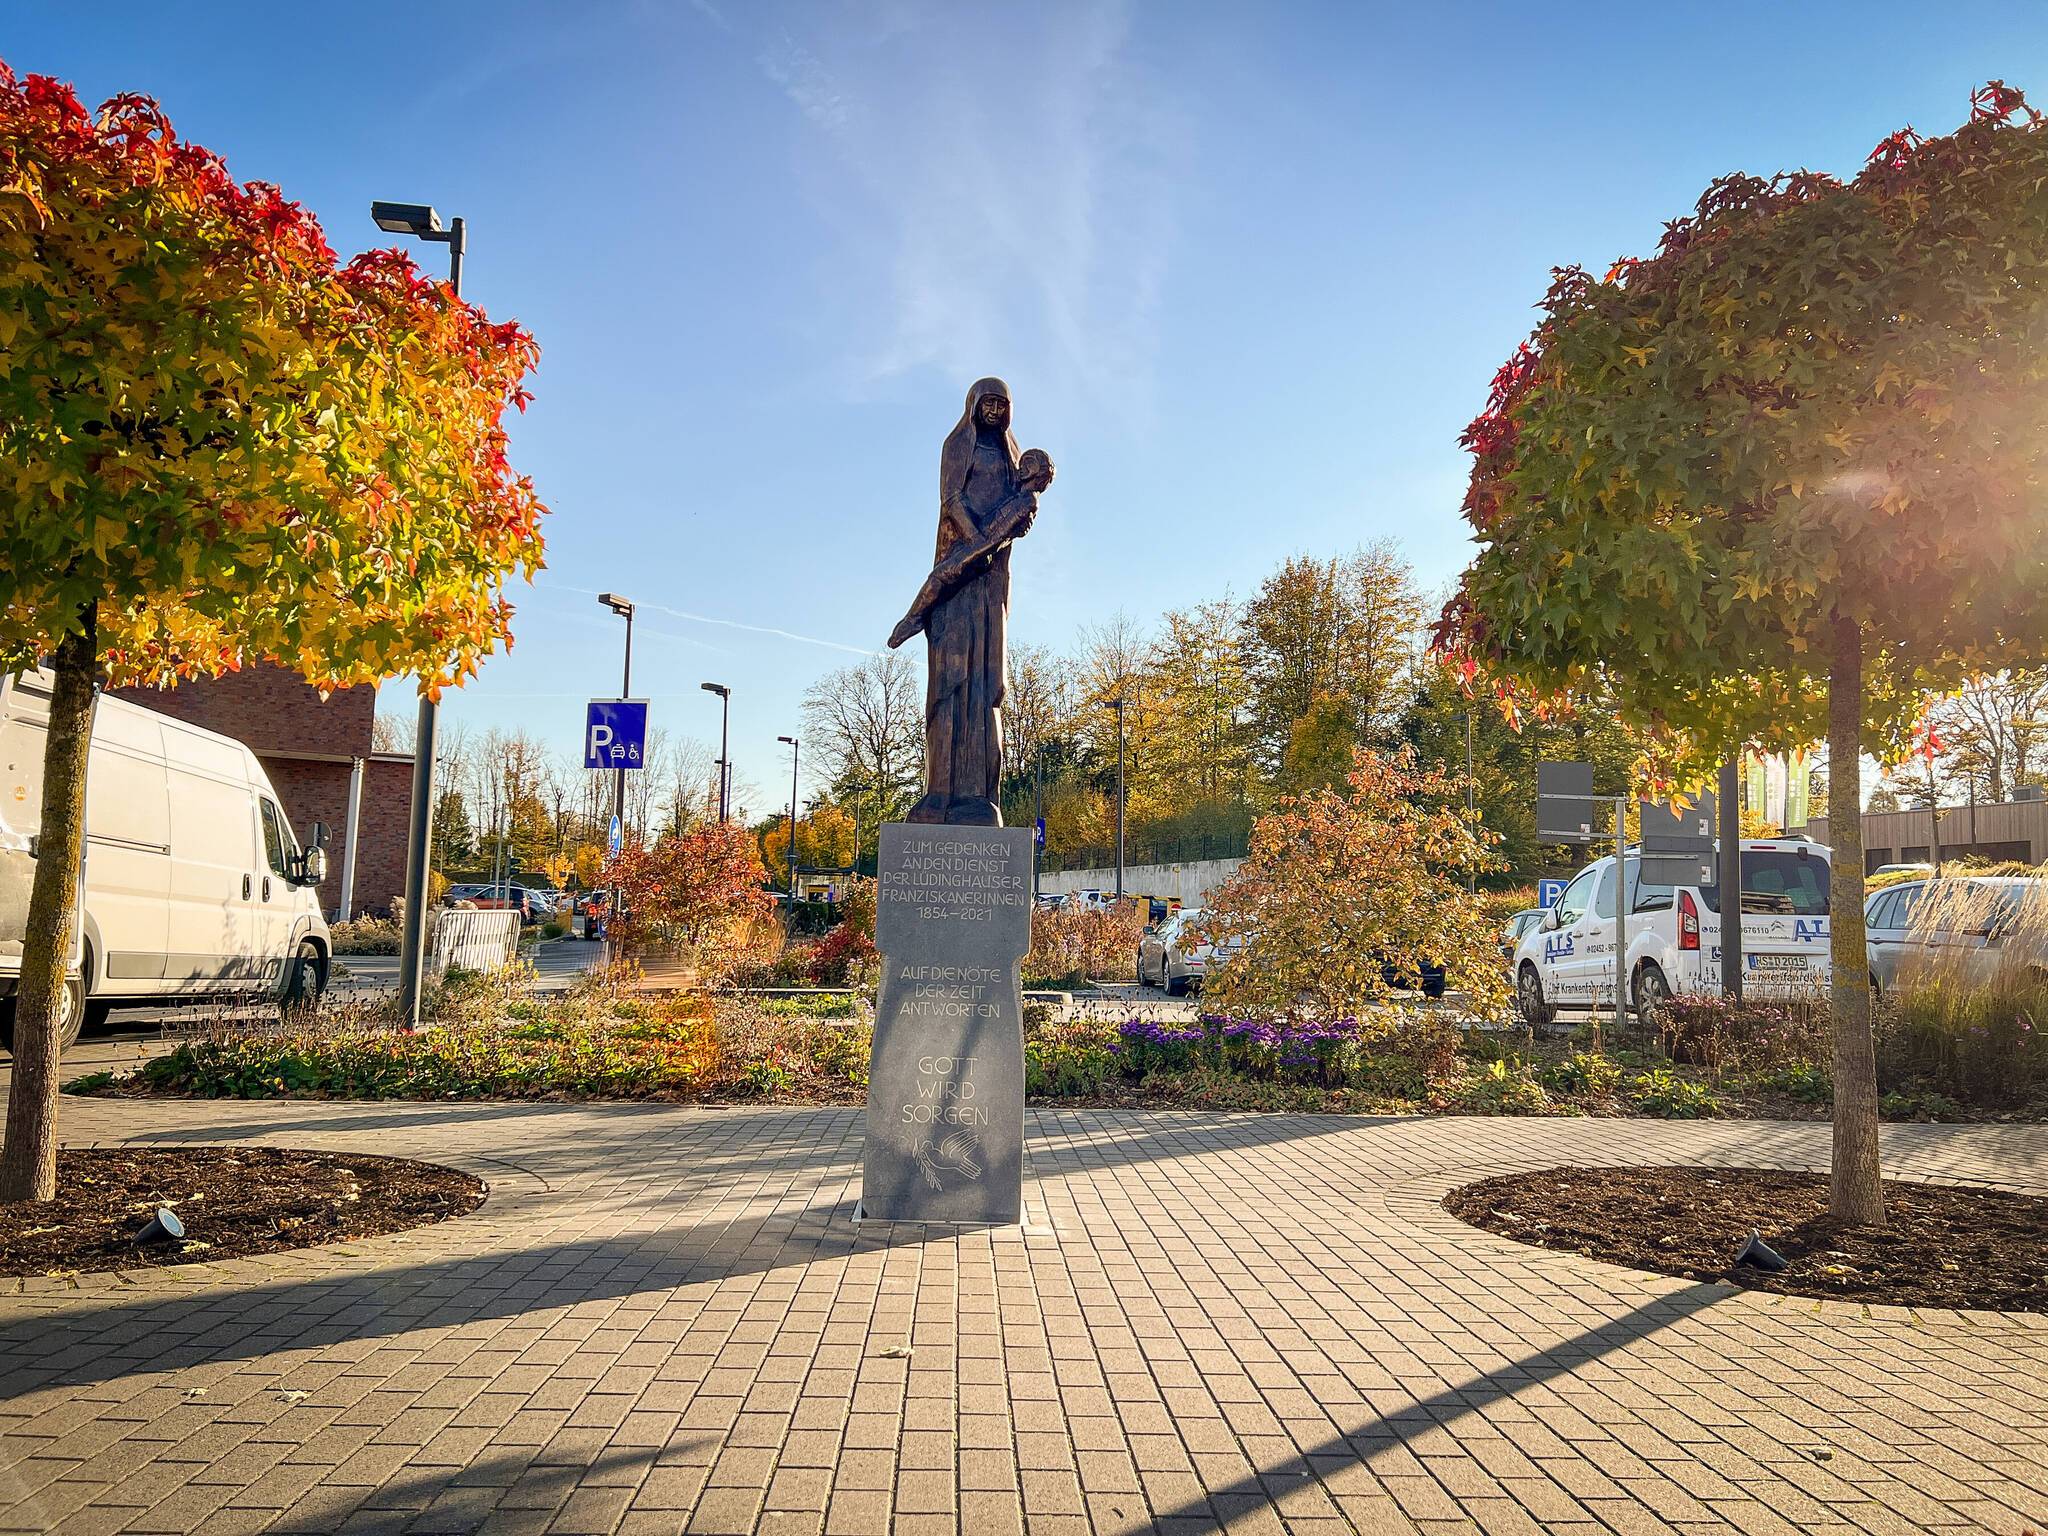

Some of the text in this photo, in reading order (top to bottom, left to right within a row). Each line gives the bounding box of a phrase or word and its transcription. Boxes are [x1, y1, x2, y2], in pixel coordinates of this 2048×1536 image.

[590, 725, 613, 759] P
[1036, 826, 1042, 840] P
[902, 840, 1011, 857] ZUM GEDENKEN
[902, 857, 1009, 873] AN DEN DIENST
[883, 871, 1024, 890] DER LÜDINGHAUSER
[882, 888, 1025, 906] FRANZISKANERINNEN
[1546, 883, 1561, 906] P
[1740, 926, 1770, 934] 676110
[1782, 957, 1806, 967] 2015
[900, 964, 1001, 983] AUF DIE NÖTE
[915, 983, 986, 999] DER ZEIT
[900, 1001, 1000, 1018] ANTWORTEN
[918, 1056, 978, 1075] GOTT
[916, 1079, 976, 1100] WIRD
[901, 1104, 989, 1126] SORGEN
